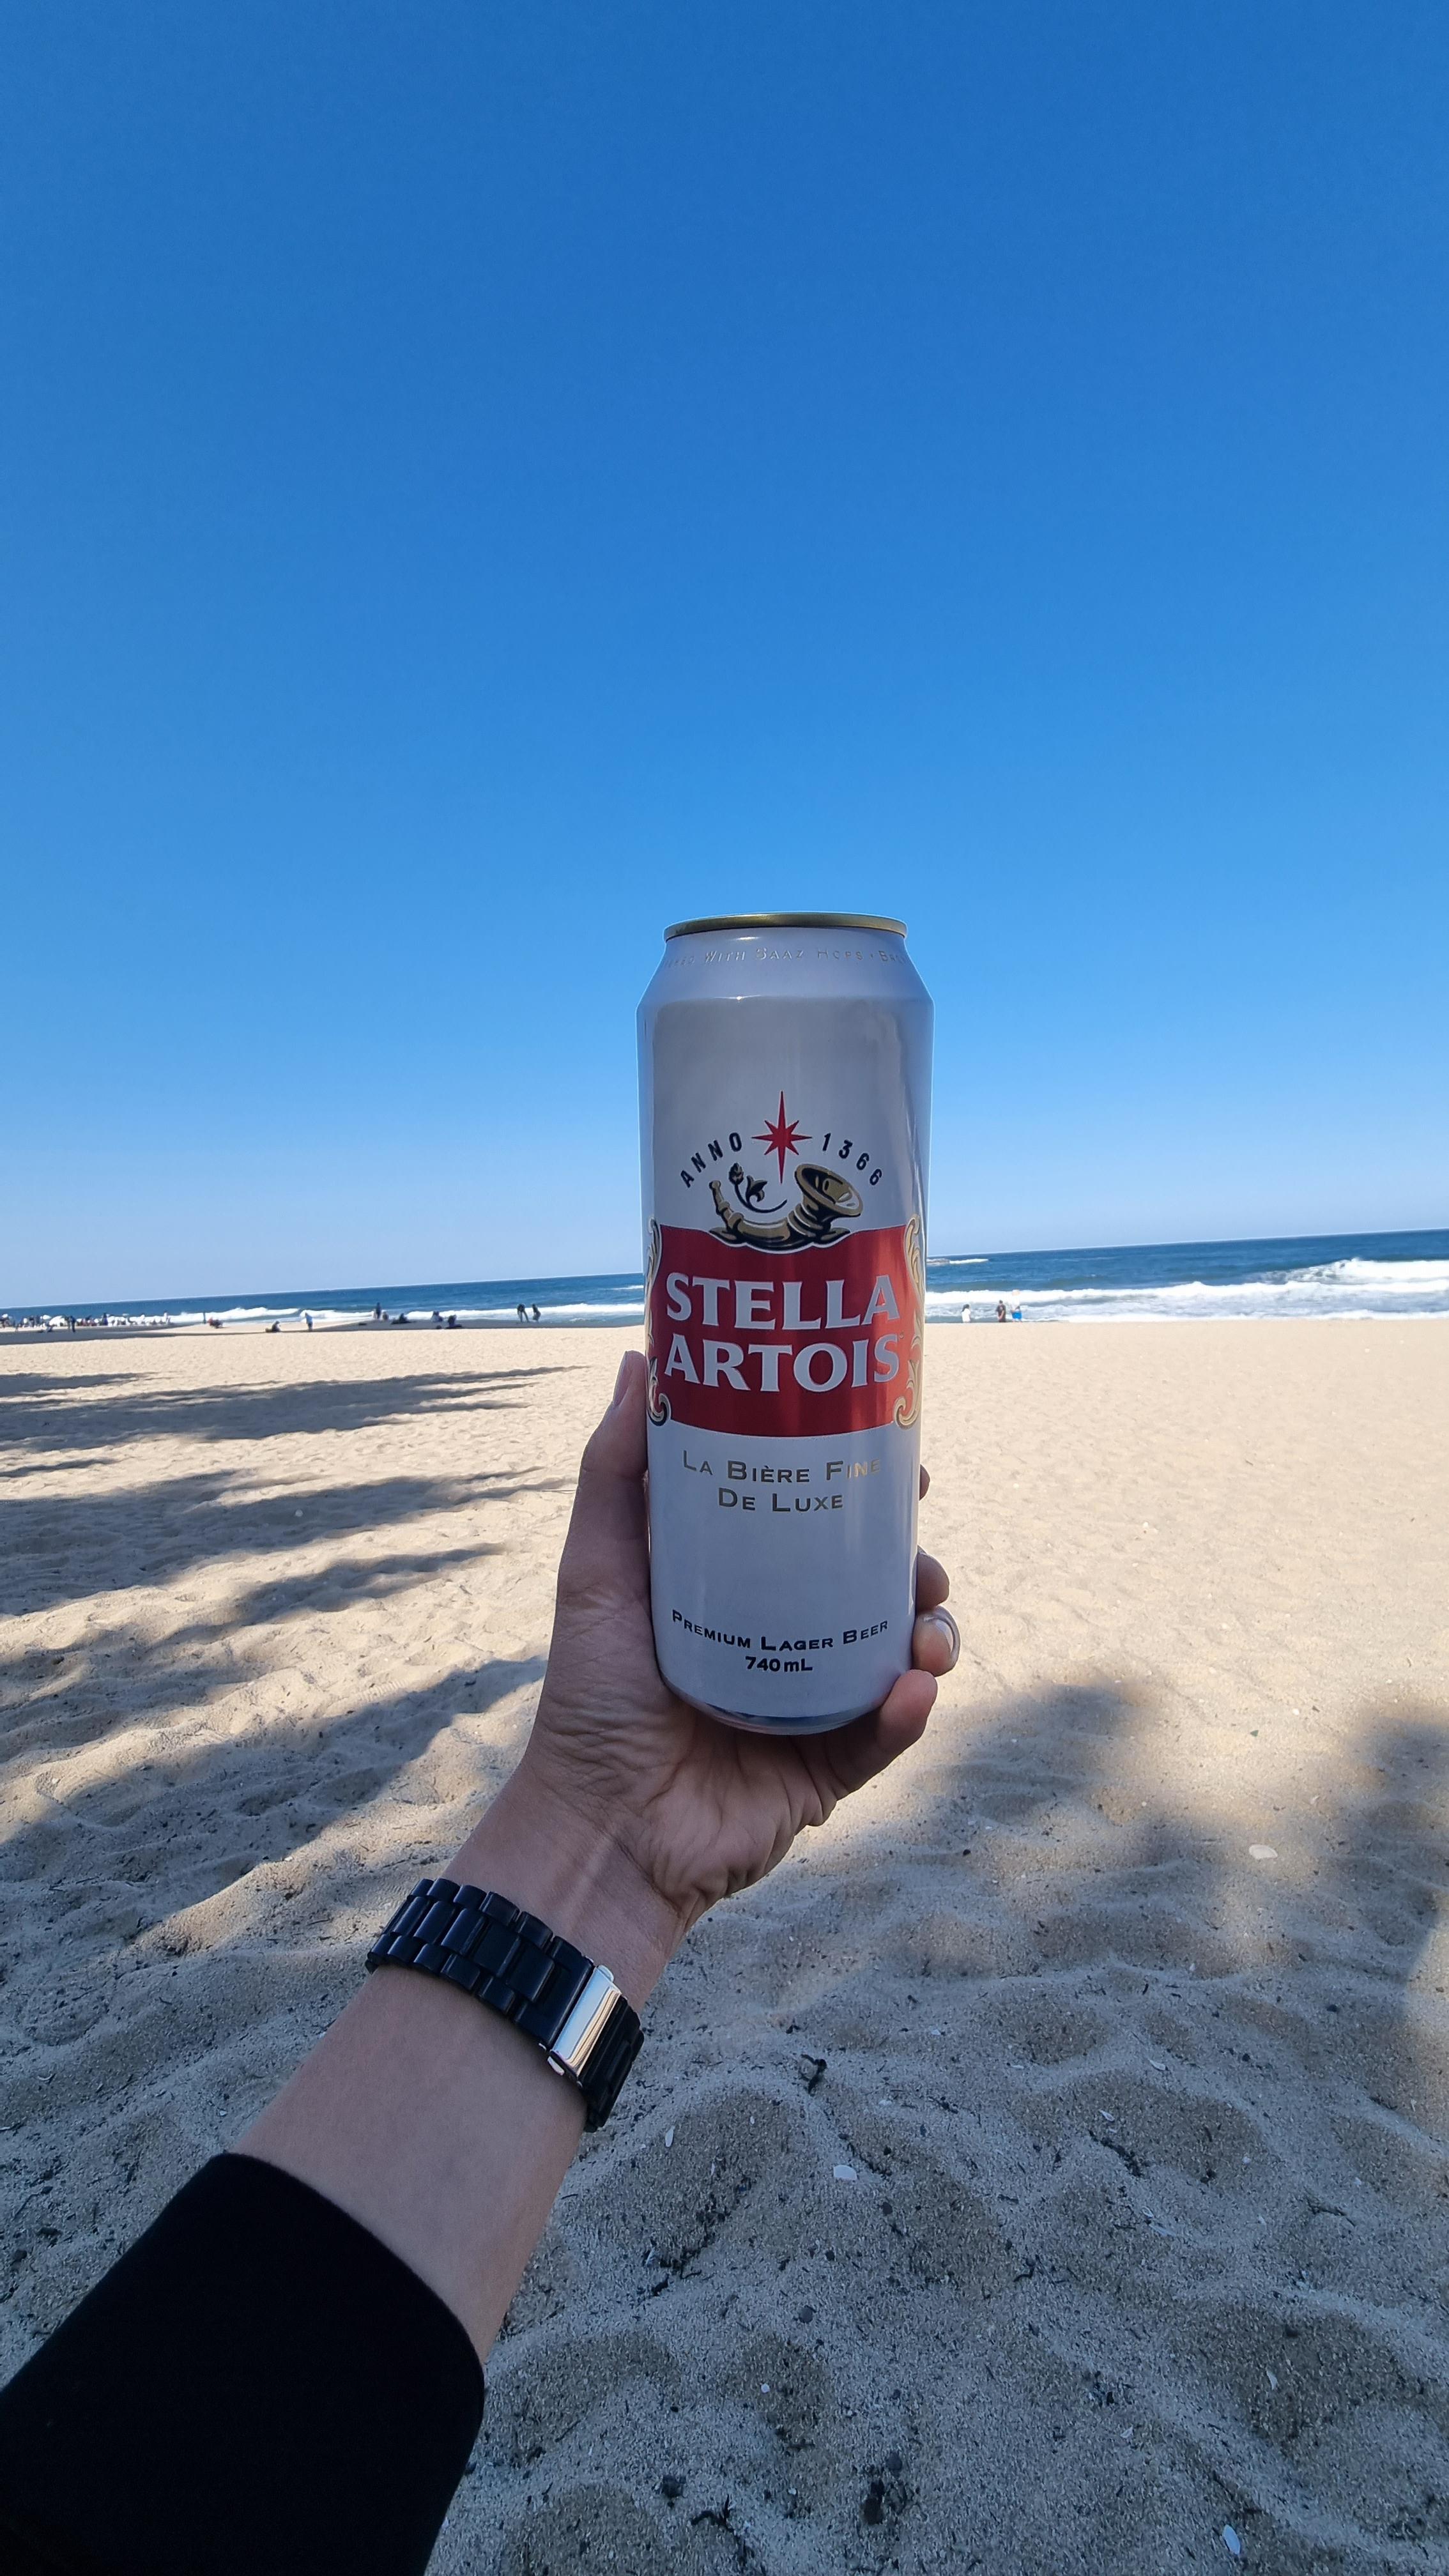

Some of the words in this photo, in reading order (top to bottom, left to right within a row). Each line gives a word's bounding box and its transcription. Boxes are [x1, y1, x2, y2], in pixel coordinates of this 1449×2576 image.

[756, 947, 804, 960] SAAZ
[680, 1132, 742, 1188] ANNO
[822, 1132, 884, 1186] 1366
[666, 1272, 900, 1331] STELLA
[664, 1333, 900, 1393] ARTOIS
[683, 1450, 713, 1475] LA
[727, 1460, 810, 1483] BIÈRE
[826, 1459, 881, 1480] FINE
[718, 1487, 756, 1510] DE
[772, 1492, 844, 1512] LUXE
[672, 1609, 751, 1649] PREMIUM
[761, 1636, 834, 1652] LAGER
[843, 1620, 889, 1645] BEER
